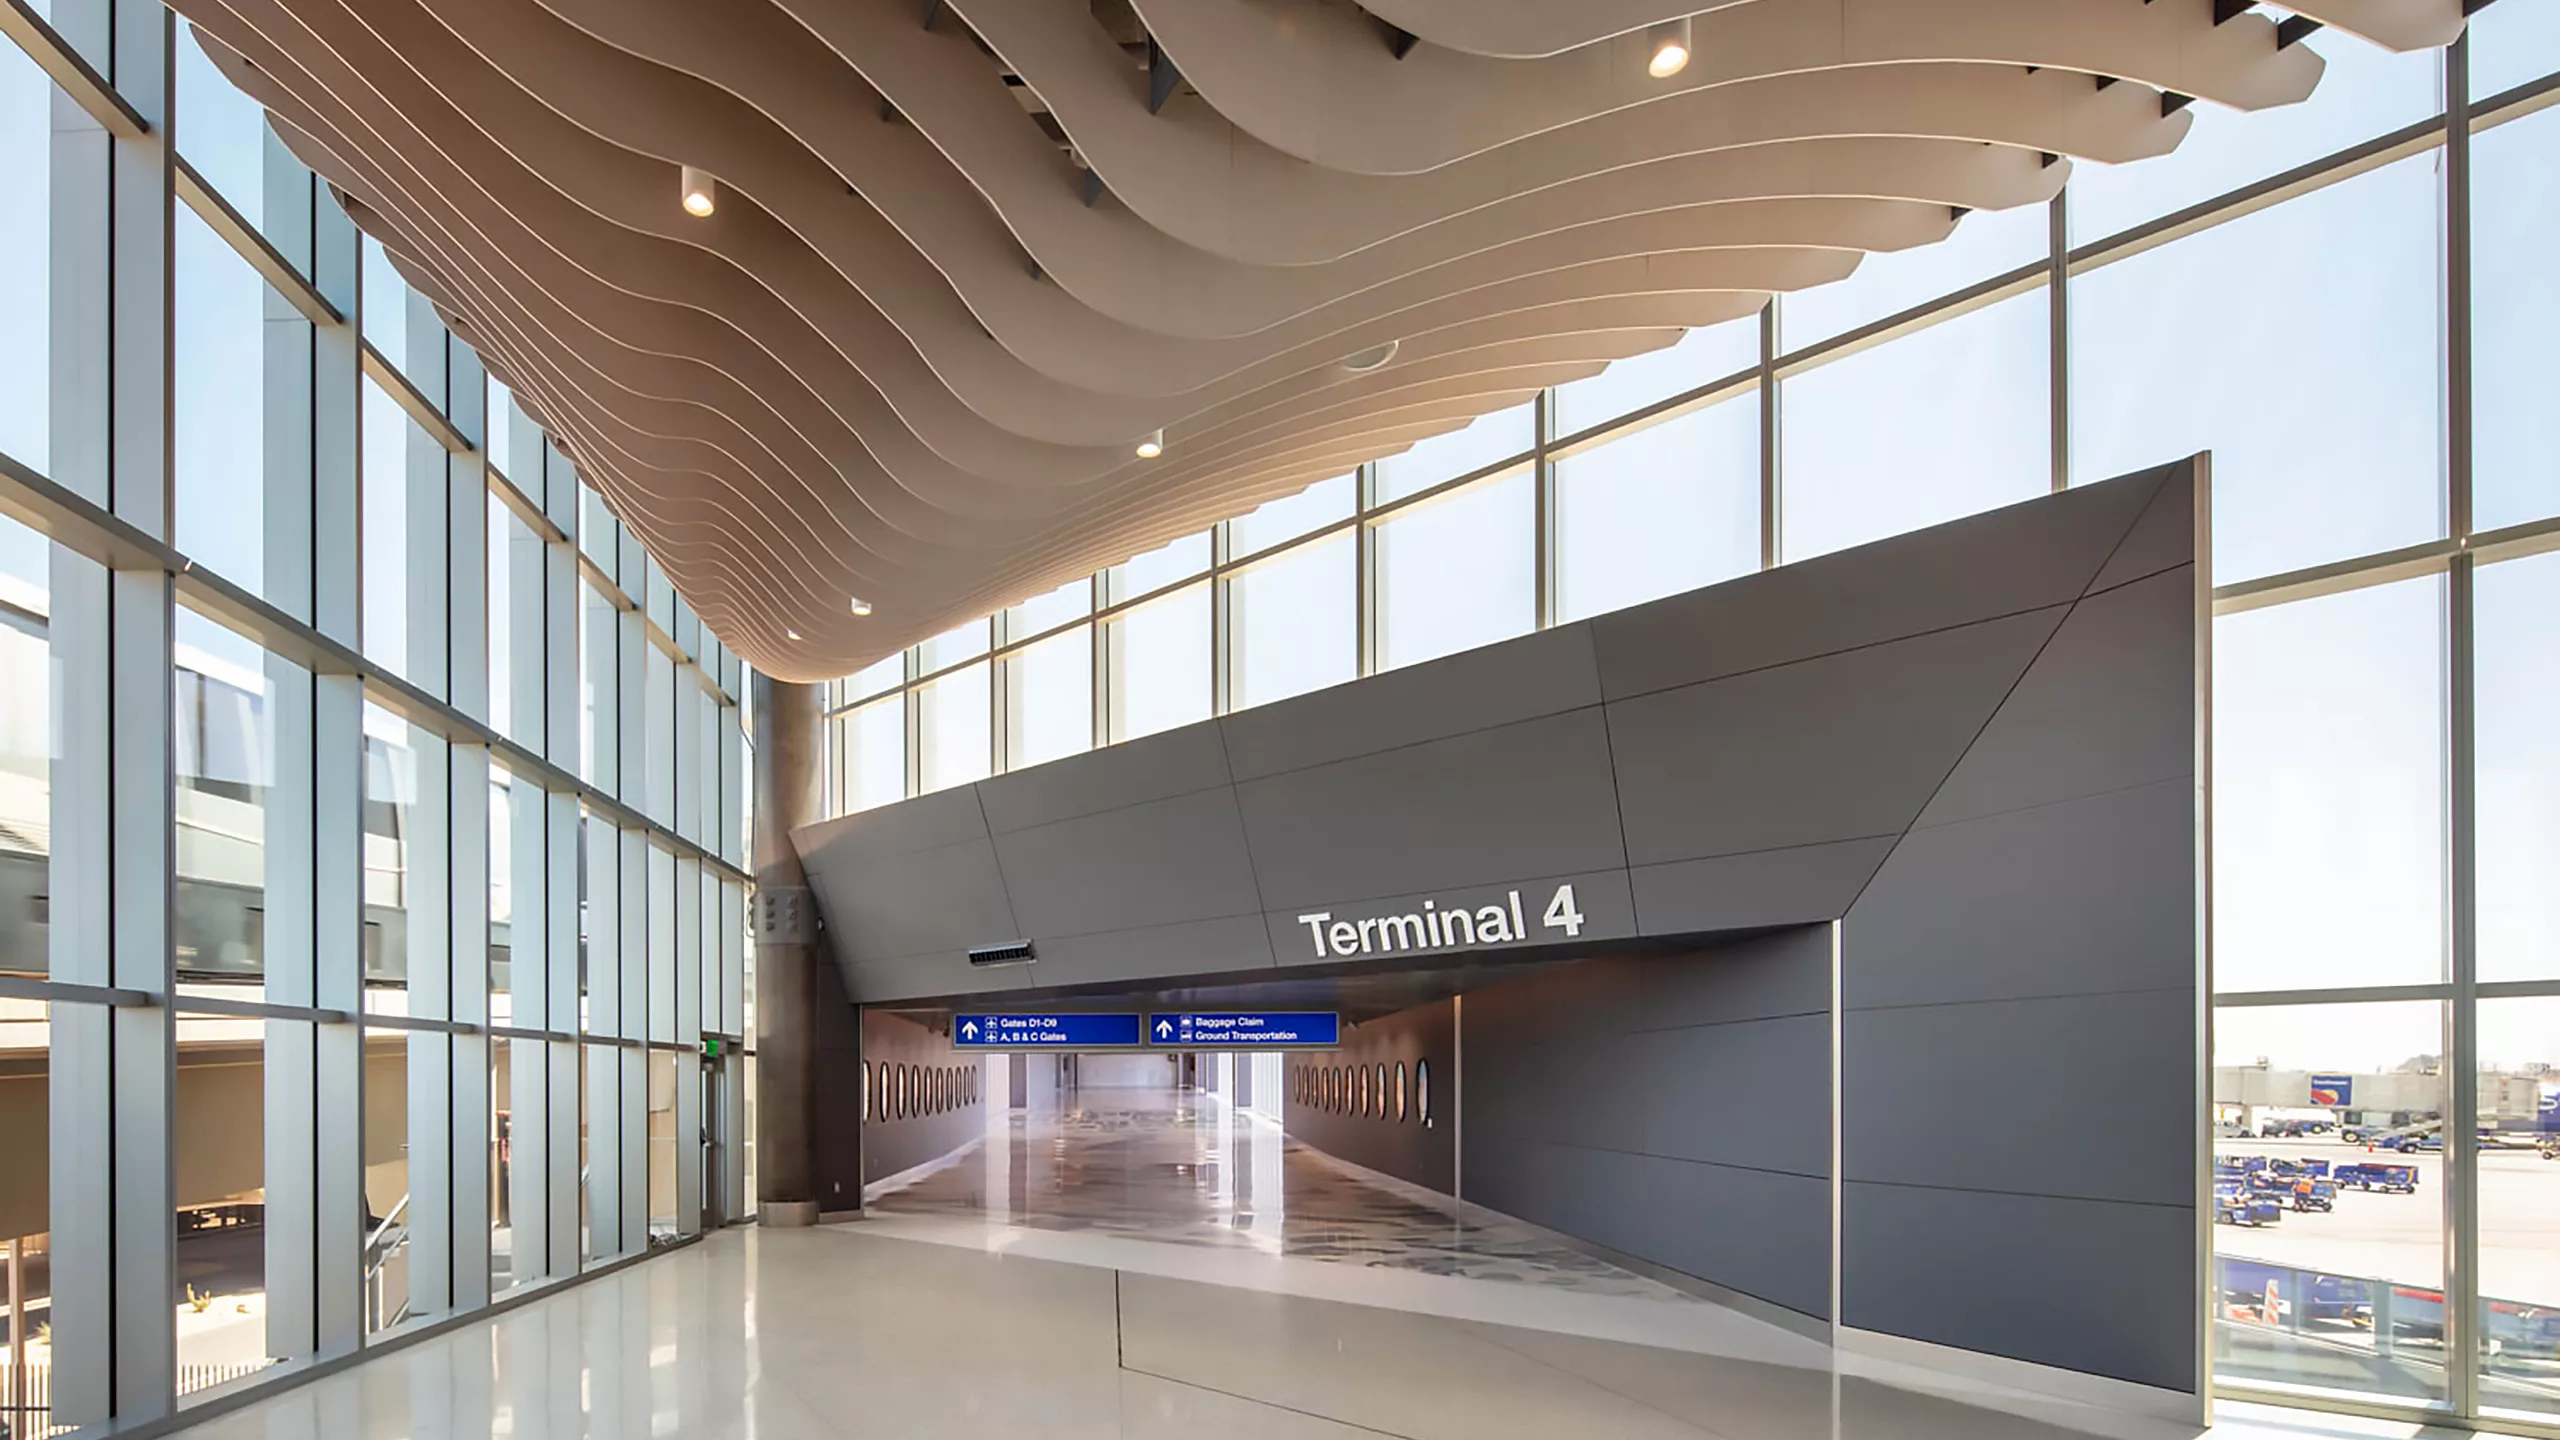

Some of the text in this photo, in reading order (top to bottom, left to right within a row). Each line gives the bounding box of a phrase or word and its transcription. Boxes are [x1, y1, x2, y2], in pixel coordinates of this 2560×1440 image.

[1298, 884, 1584, 957] Terminal 4
[1000, 1018, 1027, 1028] Gates
[1195, 1017, 1264, 1029] Baggage Claim
[1030, 1032, 1039, 1041] C
[1040, 1032, 1067, 1041] Gates
[1195, 1031, 1298, 1042] Ground Transportation
